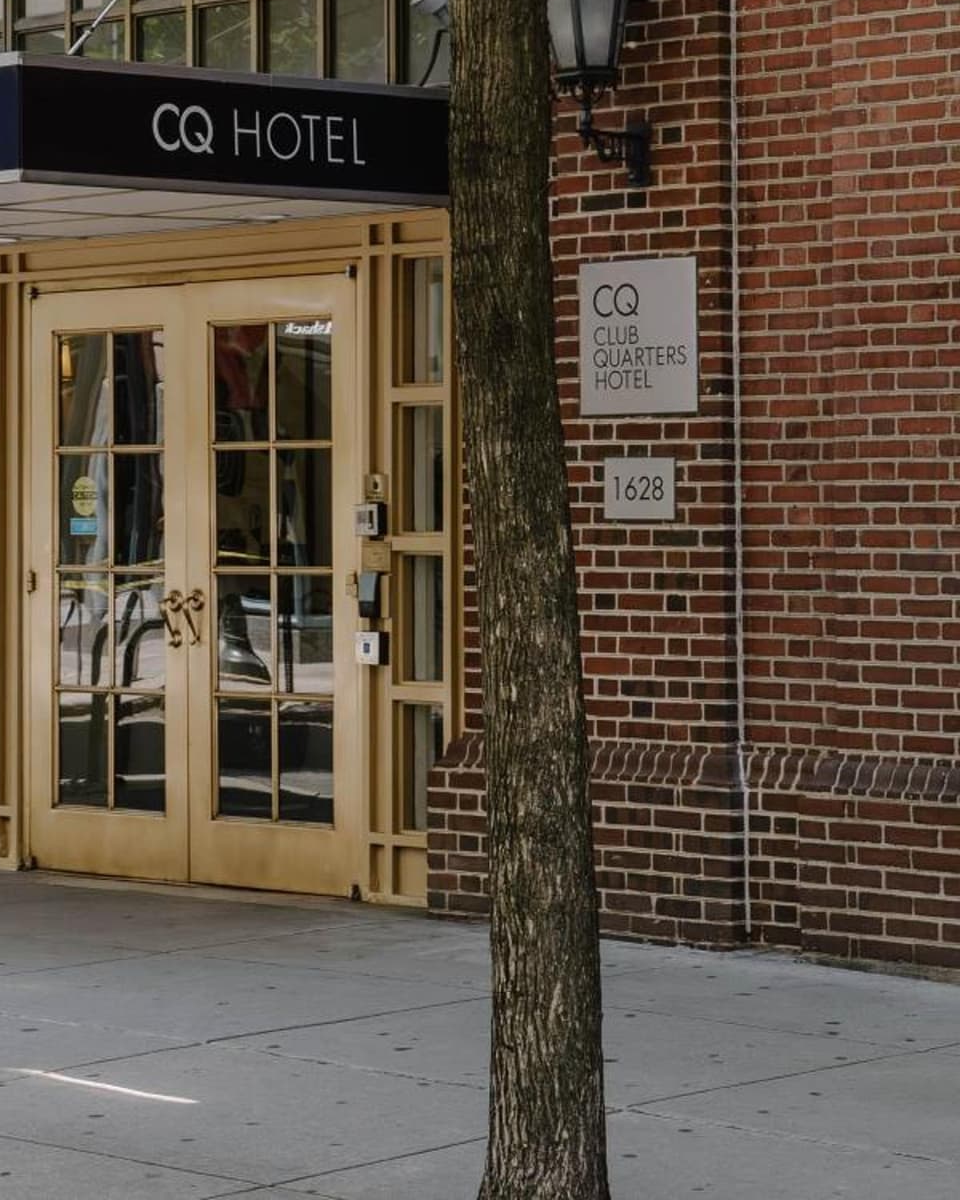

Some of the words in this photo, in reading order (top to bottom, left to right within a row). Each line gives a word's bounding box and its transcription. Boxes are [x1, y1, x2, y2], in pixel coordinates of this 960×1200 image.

[152, 102, 214, 155] CQ
[233, 108, 366, 166] HOTEL
[593, 283, 639, 318] CQ
[593, 326, 639, 346] CLUB
[593, 345, 687, 368] QUARTERS
[595, 369, 653, 390] HOTEL
[613, 475, 664, 501] 1628
